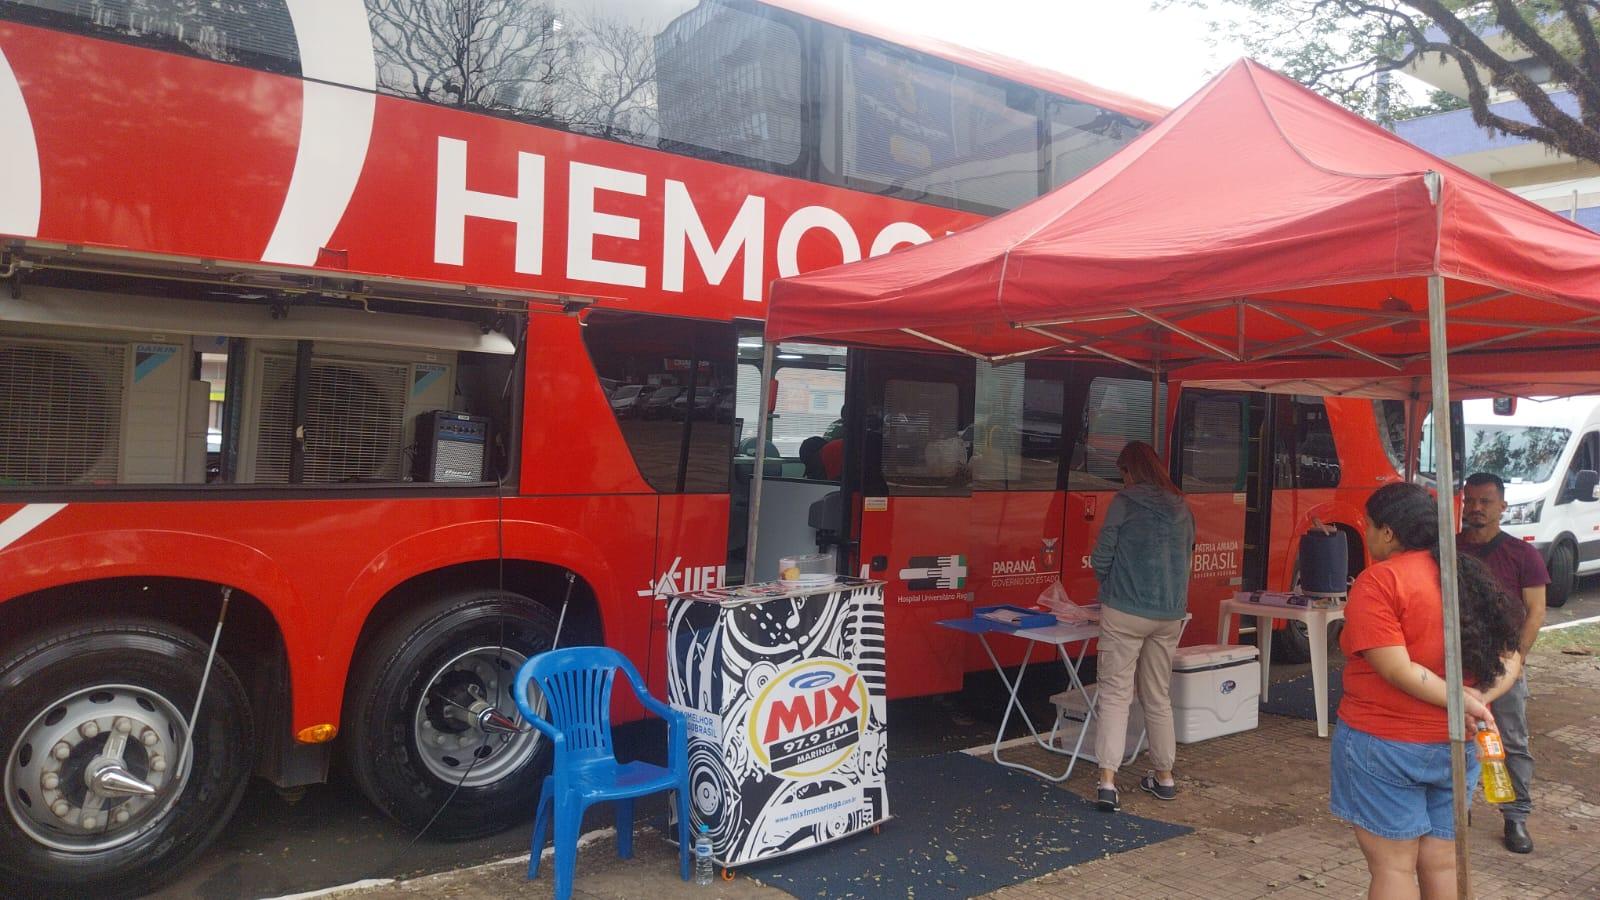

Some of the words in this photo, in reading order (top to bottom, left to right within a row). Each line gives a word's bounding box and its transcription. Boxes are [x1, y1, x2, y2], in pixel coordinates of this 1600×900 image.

[992, 556, 1036, 574] PARANÁ
[1194, 552, 1238, 572] BRASIL
[991, 577, 1024, 588] GOVERNO
[1025, 577, 1036, 585] DO
[1036, 575, 1060, 585] ESTADO
[897, 594, 921, 604] Hospital
[763, 674, 860, 744] MIX
[694, 723, 718, 738] BRASIL
[783, 733, 821, 753] 97.9
[826, 722, 849, 740] FM
[797, 742, 838, 764] MARINGÁ
[775, 796, 857, 823] www.mixfmmaringa.com.br
